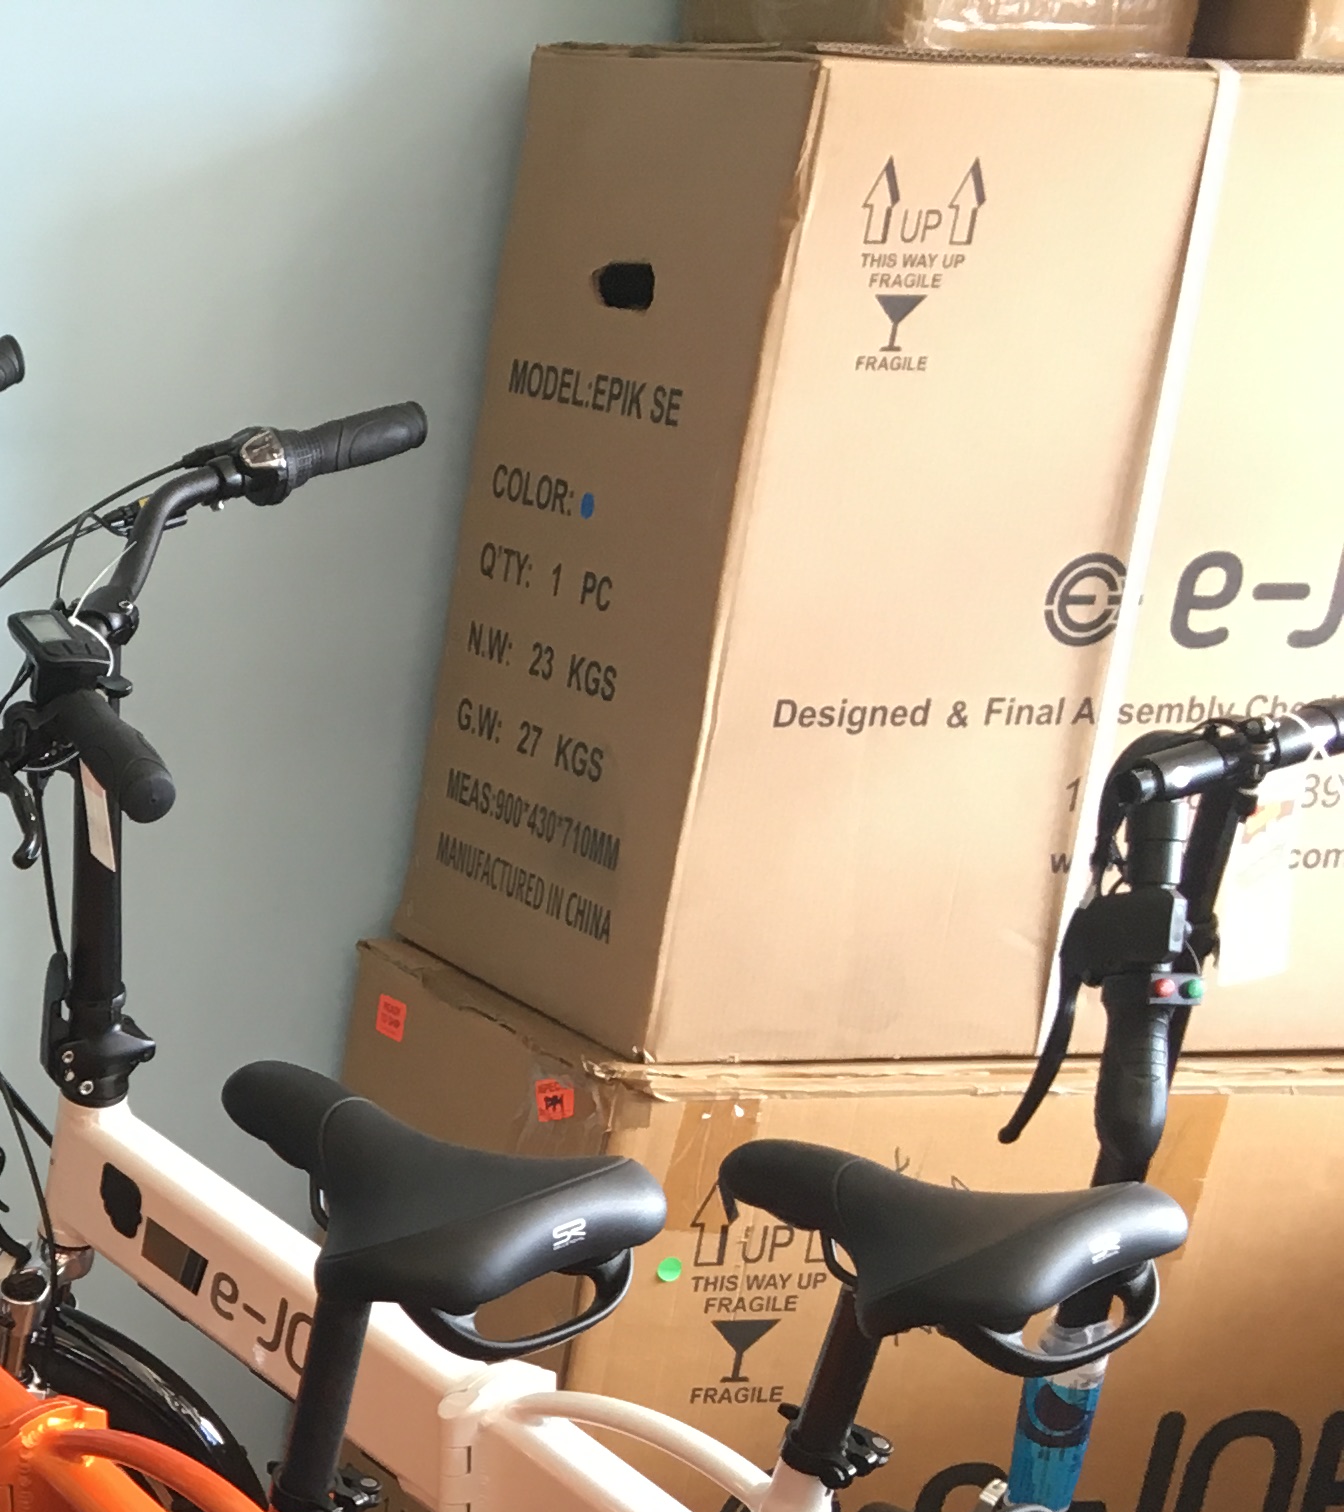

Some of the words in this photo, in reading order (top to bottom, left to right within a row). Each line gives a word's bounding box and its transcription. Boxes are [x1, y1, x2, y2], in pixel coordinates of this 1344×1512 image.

[900, 208, 942, 243] UP
[861, 252, 897, 269] THIS
[902, 253, 938, 269] WAY
[942, 253, 966, 269] UP
[868, 272, 943, 289] FRAGILE
[855, 355, 928, 371] FRAGILE
[508, 358, 649, 420] MODEL:EPIK
[649, 385, 683, 428] SE
[492, 464, 575, 517] COLOR:
[480, 542, 533, 589] Q'TY:
[552, 563, 563, 597] 1
[580, 571, 613, 612] PC
[468, 620, 512, 667] N.W:
[528, 641, 554, 681] 23
[567, 653, 618, 701] KGS
[772, 697, 930, 734] Designed
[945, 703, 970, 728] &
[983, 696, 1064, 727] Final
[1070, 695, 1236, 730] Asembly
[457, 697, 503, 744] G.W:
[517, 721, 543, 758] 27
[554, 733, 605, 783] KGS
[436, 831, 545, 911] MANUFACTURED
[547, 884, 565, 921] IN
[564, 891, 612, 945] CHINA
[741, 1225, 795, 1264] UP
[691, 1274, 739, 1293] THIS
[746, 1273, 793, 1291] WAY
[797, 1272, 828, 1290] UP
[210, 1271, 314, 1377] e-JO
[703, 1294, 800, 1315] FRAGILE
[689, 1385, 785, 1405] FRAGILE
